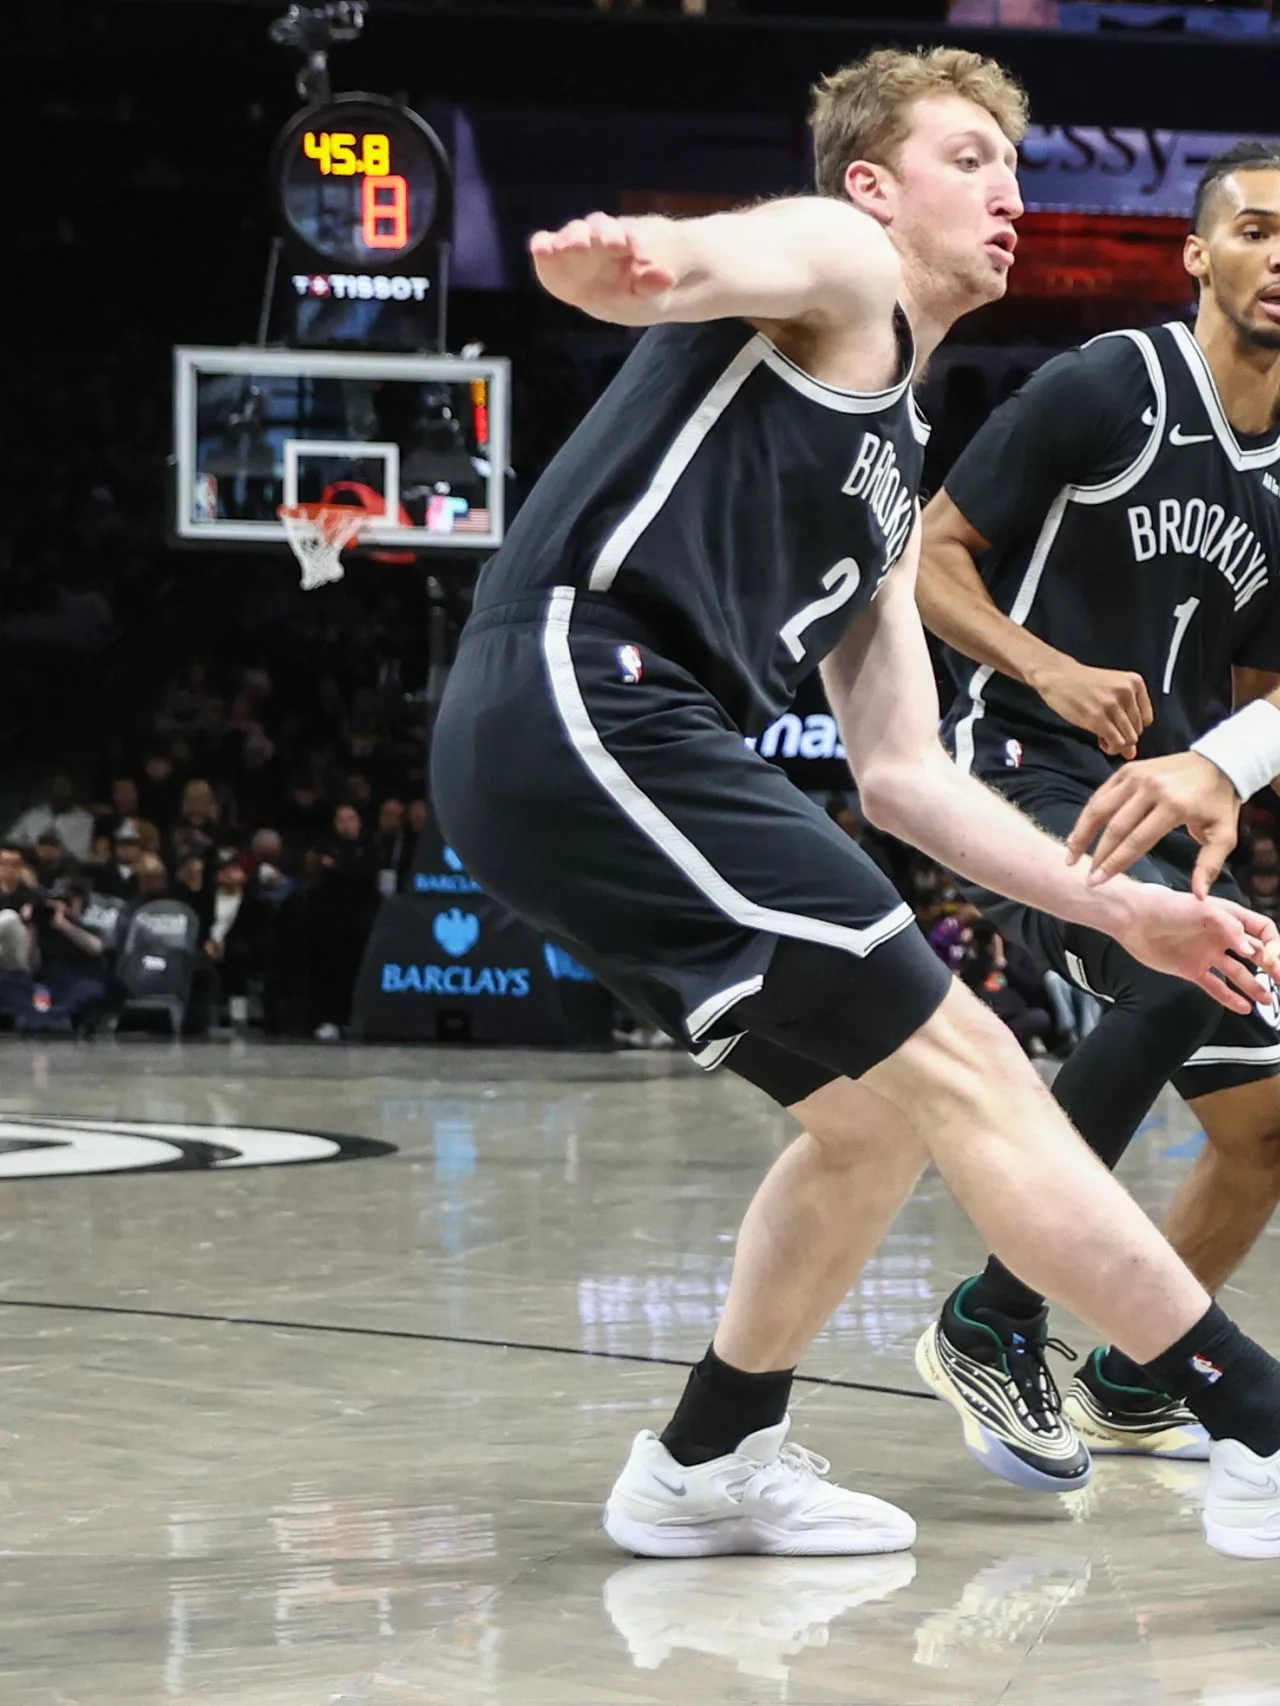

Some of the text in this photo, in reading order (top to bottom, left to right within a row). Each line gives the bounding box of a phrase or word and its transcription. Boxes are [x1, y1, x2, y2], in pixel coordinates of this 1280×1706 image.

[304, 132, 390, 176] 45.8
[362, 175, 409, 249] 8
[328, 274, 430, 301] TISSOT
[1127, 498, 1269, 612] BROOKLYN
[780, 556, 860, 663] 2
[1162, 596, 1200, 694] 1
[382, 963, 530, 997] BARCLAYS
